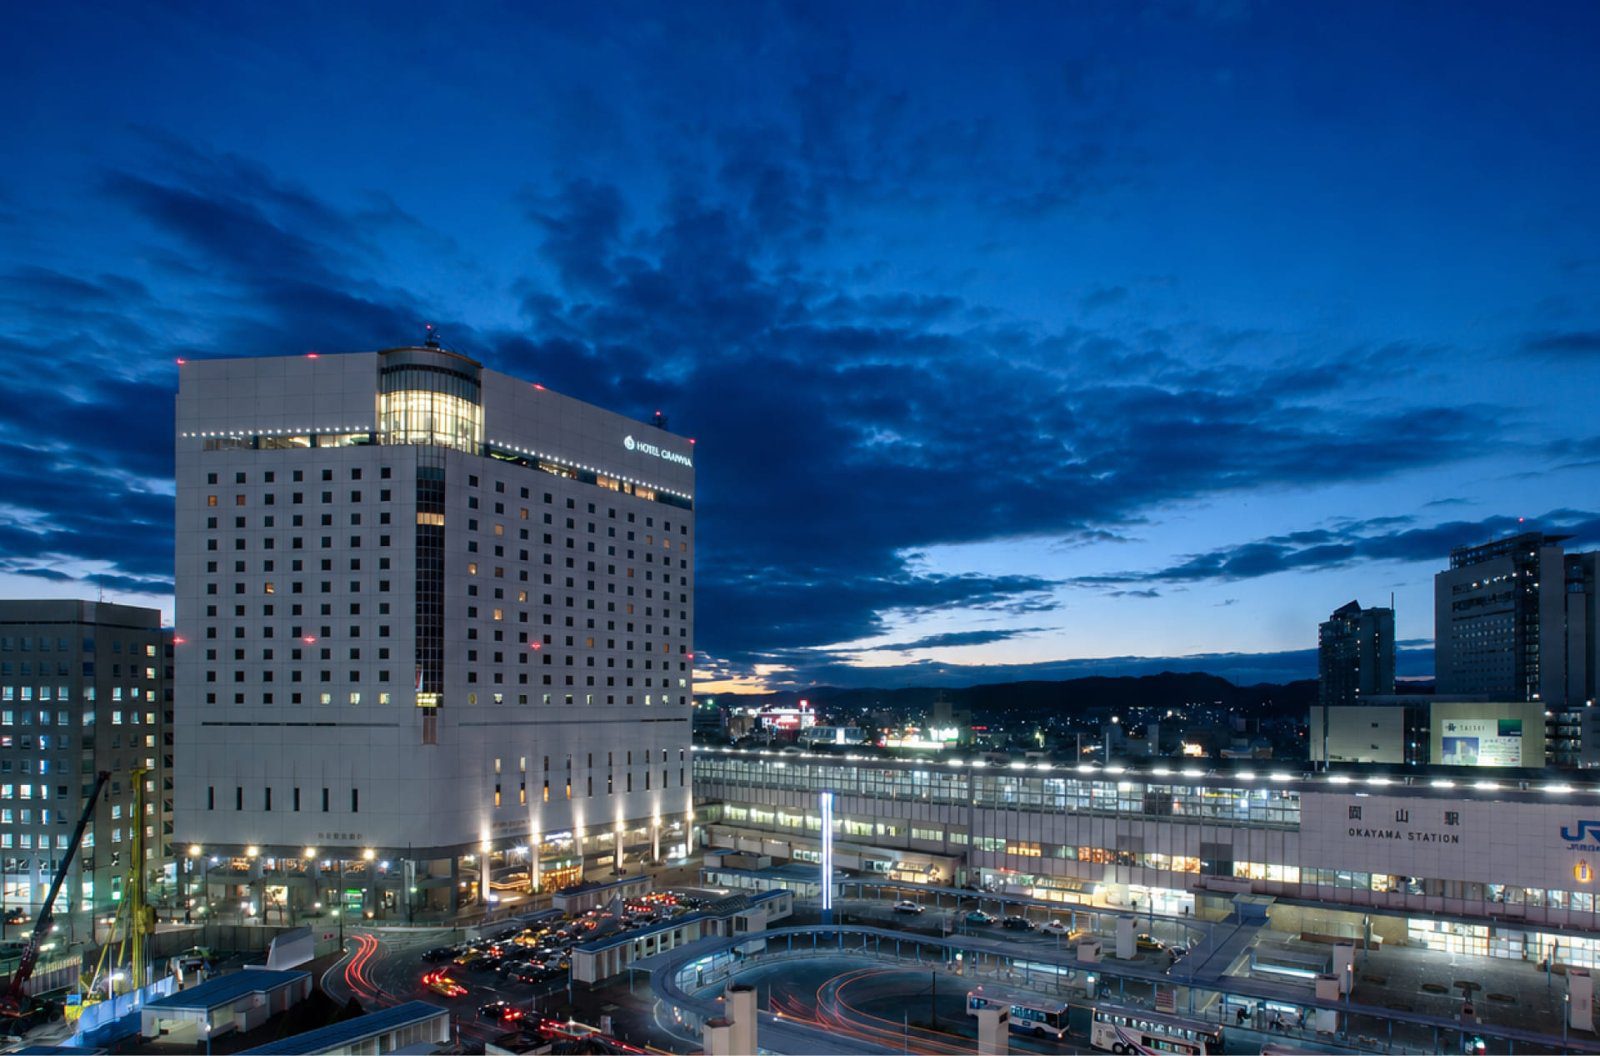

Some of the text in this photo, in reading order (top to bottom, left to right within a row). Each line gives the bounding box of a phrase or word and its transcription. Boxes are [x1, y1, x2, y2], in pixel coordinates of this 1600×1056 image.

[636, 441, 660, 457] HOTEL
[1348, 828, 1459, 844] OKAYAMA STATION
